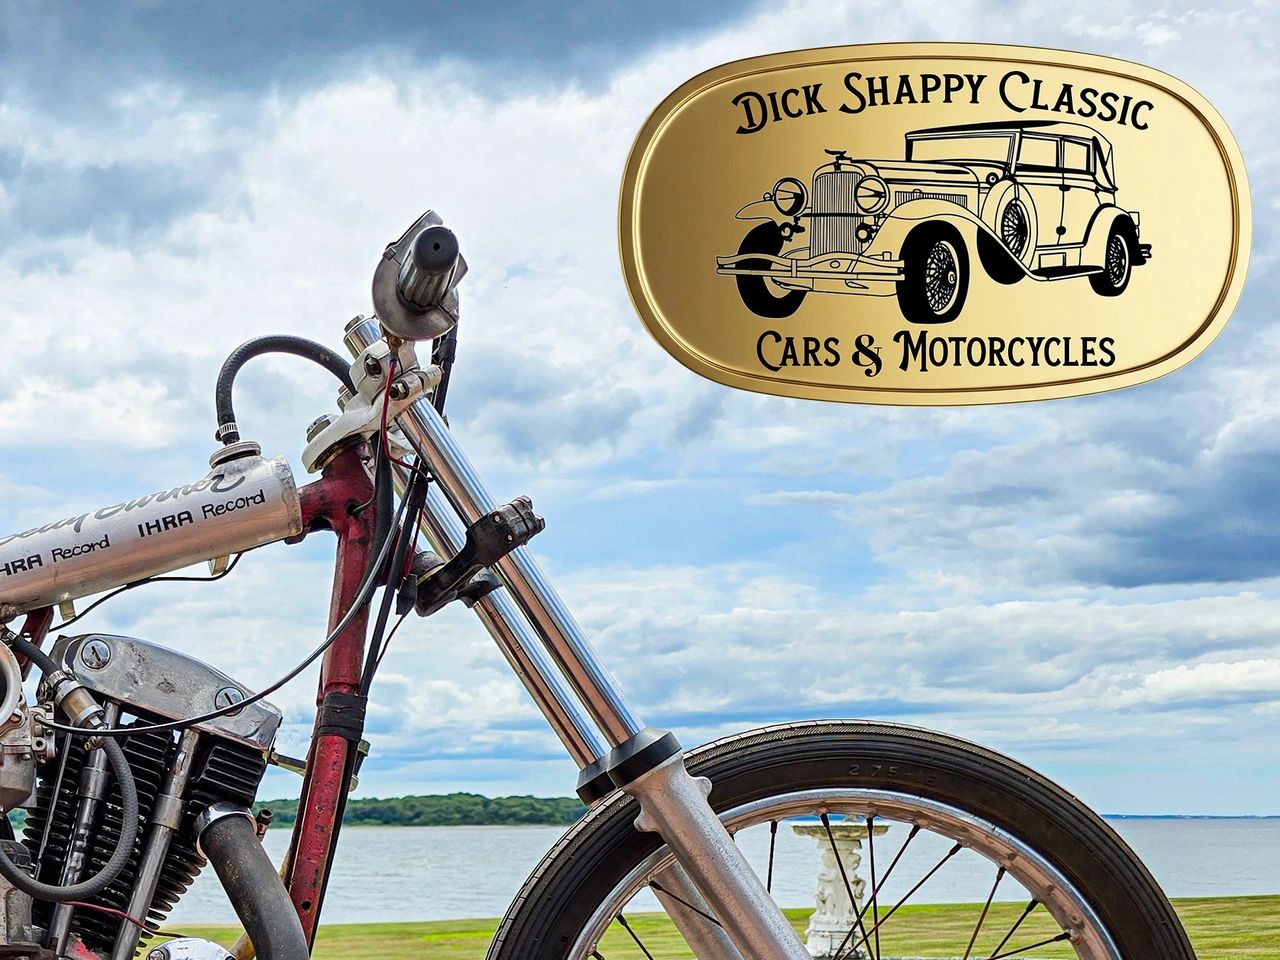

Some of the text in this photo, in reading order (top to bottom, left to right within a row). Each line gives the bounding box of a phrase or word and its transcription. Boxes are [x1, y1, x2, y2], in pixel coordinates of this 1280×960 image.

[138, 488, 266, 538] IHRA Record
[51, 534, 111, 563] Record
